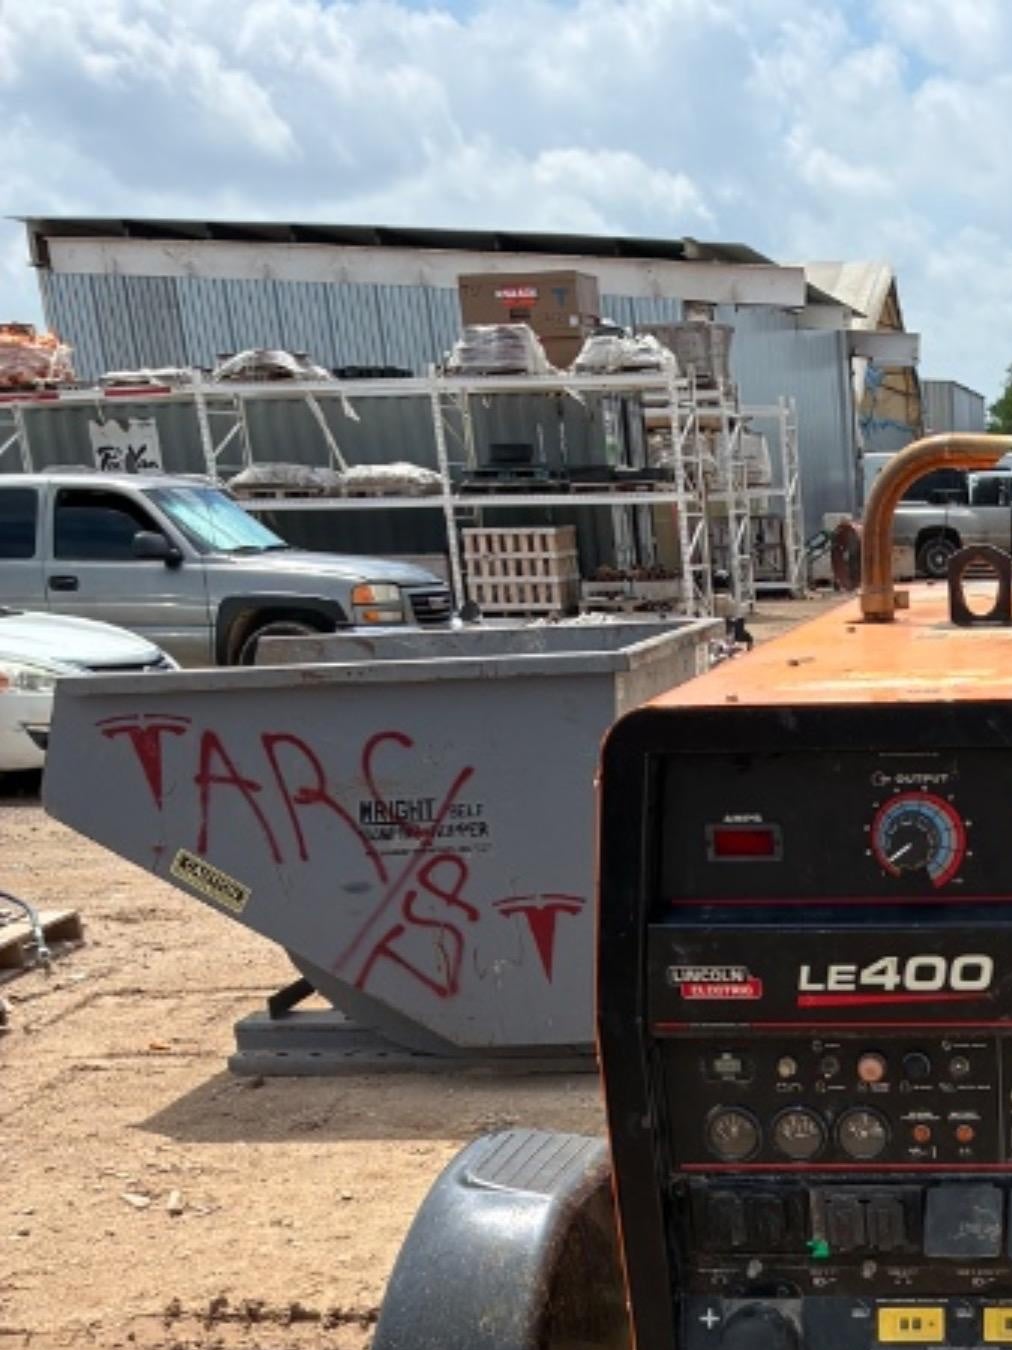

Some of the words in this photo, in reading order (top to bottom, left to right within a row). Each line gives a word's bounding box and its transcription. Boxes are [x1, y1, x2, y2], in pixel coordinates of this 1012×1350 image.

[895, 774, 949, 784] OUTPUT
[359, 798, 436, 823] WRIGHT
[673, 968, 745, 982] LINCOLN
[799, 955, 993, 991] LE400
[691, 984, 755, 996] ELECTRIC
